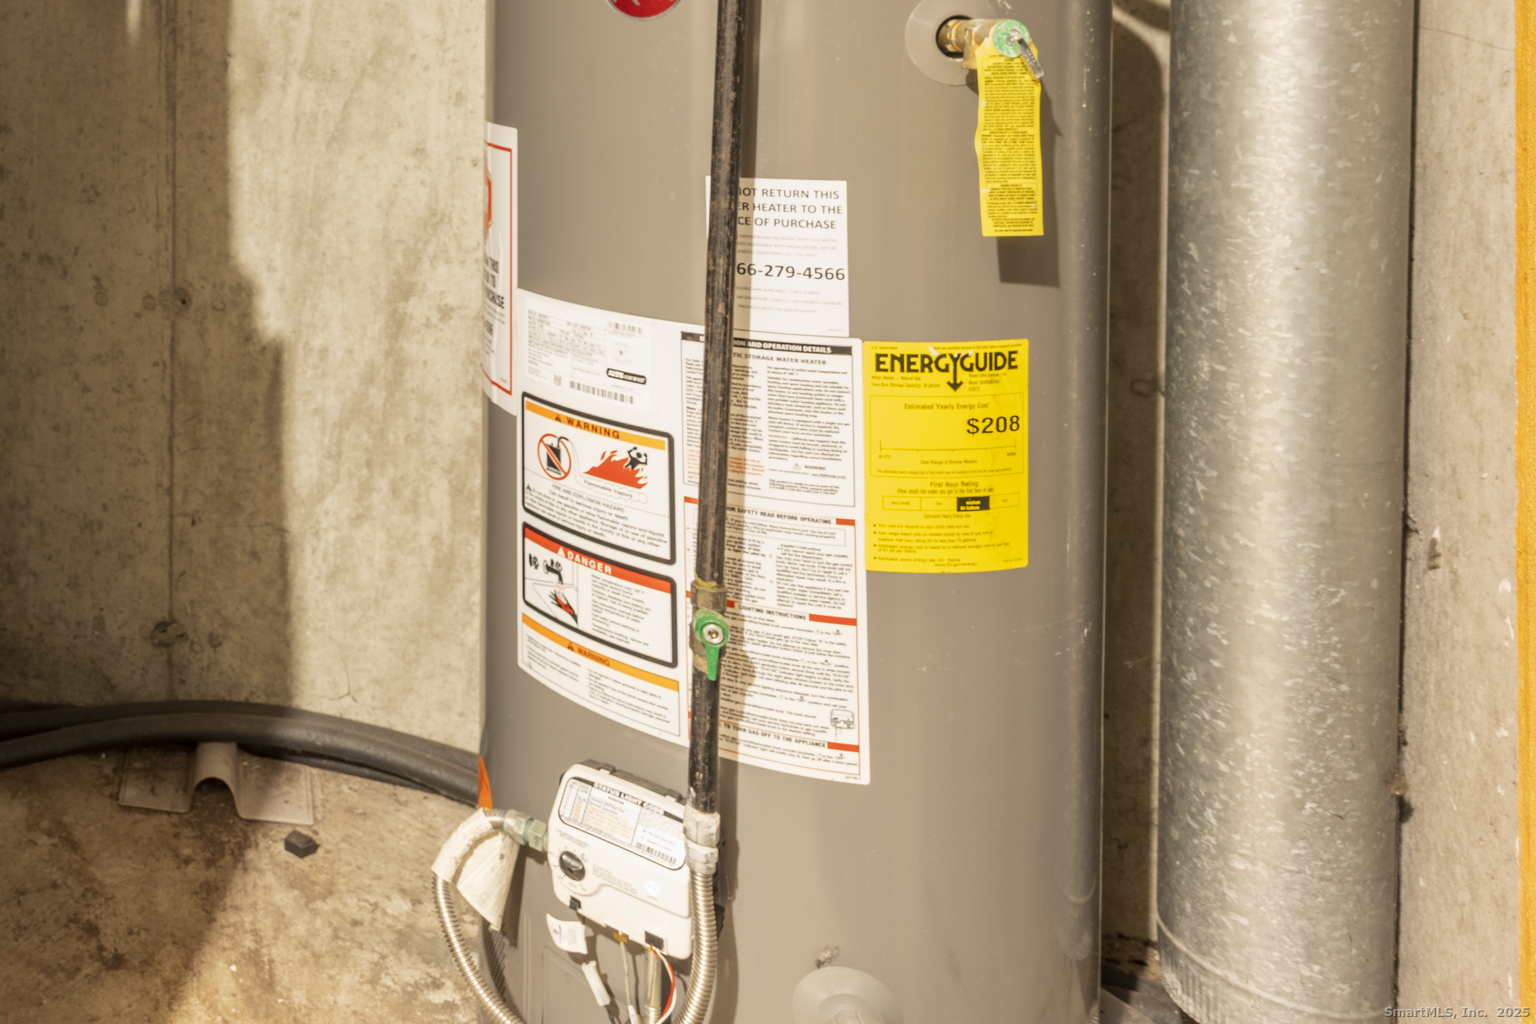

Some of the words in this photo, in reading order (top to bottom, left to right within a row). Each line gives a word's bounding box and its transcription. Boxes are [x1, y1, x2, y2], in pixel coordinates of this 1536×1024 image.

[761, 188, 810, 199] RETURN
[813, 189, 840, 200] THIS
[752, 202, 798, 213] HEATER
[801, 204, 817, 214] TO
[820, 205, 843, 215] THE
[754, 217, 770, 227] OF
[773, 218, 837, 230] PURCHASE
[736, 262, 845, 281] 66-279-4566
[749, 341, 762, 349] AND
[762, 342, 803, 352] OPERATION
[803, 345, 832, 354] DETAILS
[748, 353, 774, 362] STORAGE
[776, 356, 799, 364] WATER
[874, 350, 1018, 373] ENERGYGUIDE
[936, 403, 955, 411] Yearly
[956, 403, 976, 411] Energy
[566, 416, 620, 440] WARNING
[966, 415, 1020, 437] $208
[929, 480, 943, 488] First
[945, 480, 959, 488] Hour
[960, 480, 979, 488] Rating
[573, 491, 601, 506] EXPLOSION
[602, 502, 625, 513] HAZARD
[737, 508, 758, 517] SAFETY
[760, 511, 775, 519] READ
[776, 512, 798, 521] BEFORE
[799, 515, 832, 525] OPERATING
[567, 549, 612, 575] DANGER
[738, 604, 764, 615] LIGHTING
[765, 609, 807, 621] INSTRUCTIONS
[577, 647, 611, 667] WARNING
[748, 728, 760, 736] GAS
[760, 730, 771, 739] OFF
[782, 734, 793, 742] THE
[794, 736, 826, 748] APPLIANCE
[593, 782, 620, 797] STATUS
[620, 791, 643, 806] LIGHT
[642, 800, 665, 815] CODE
